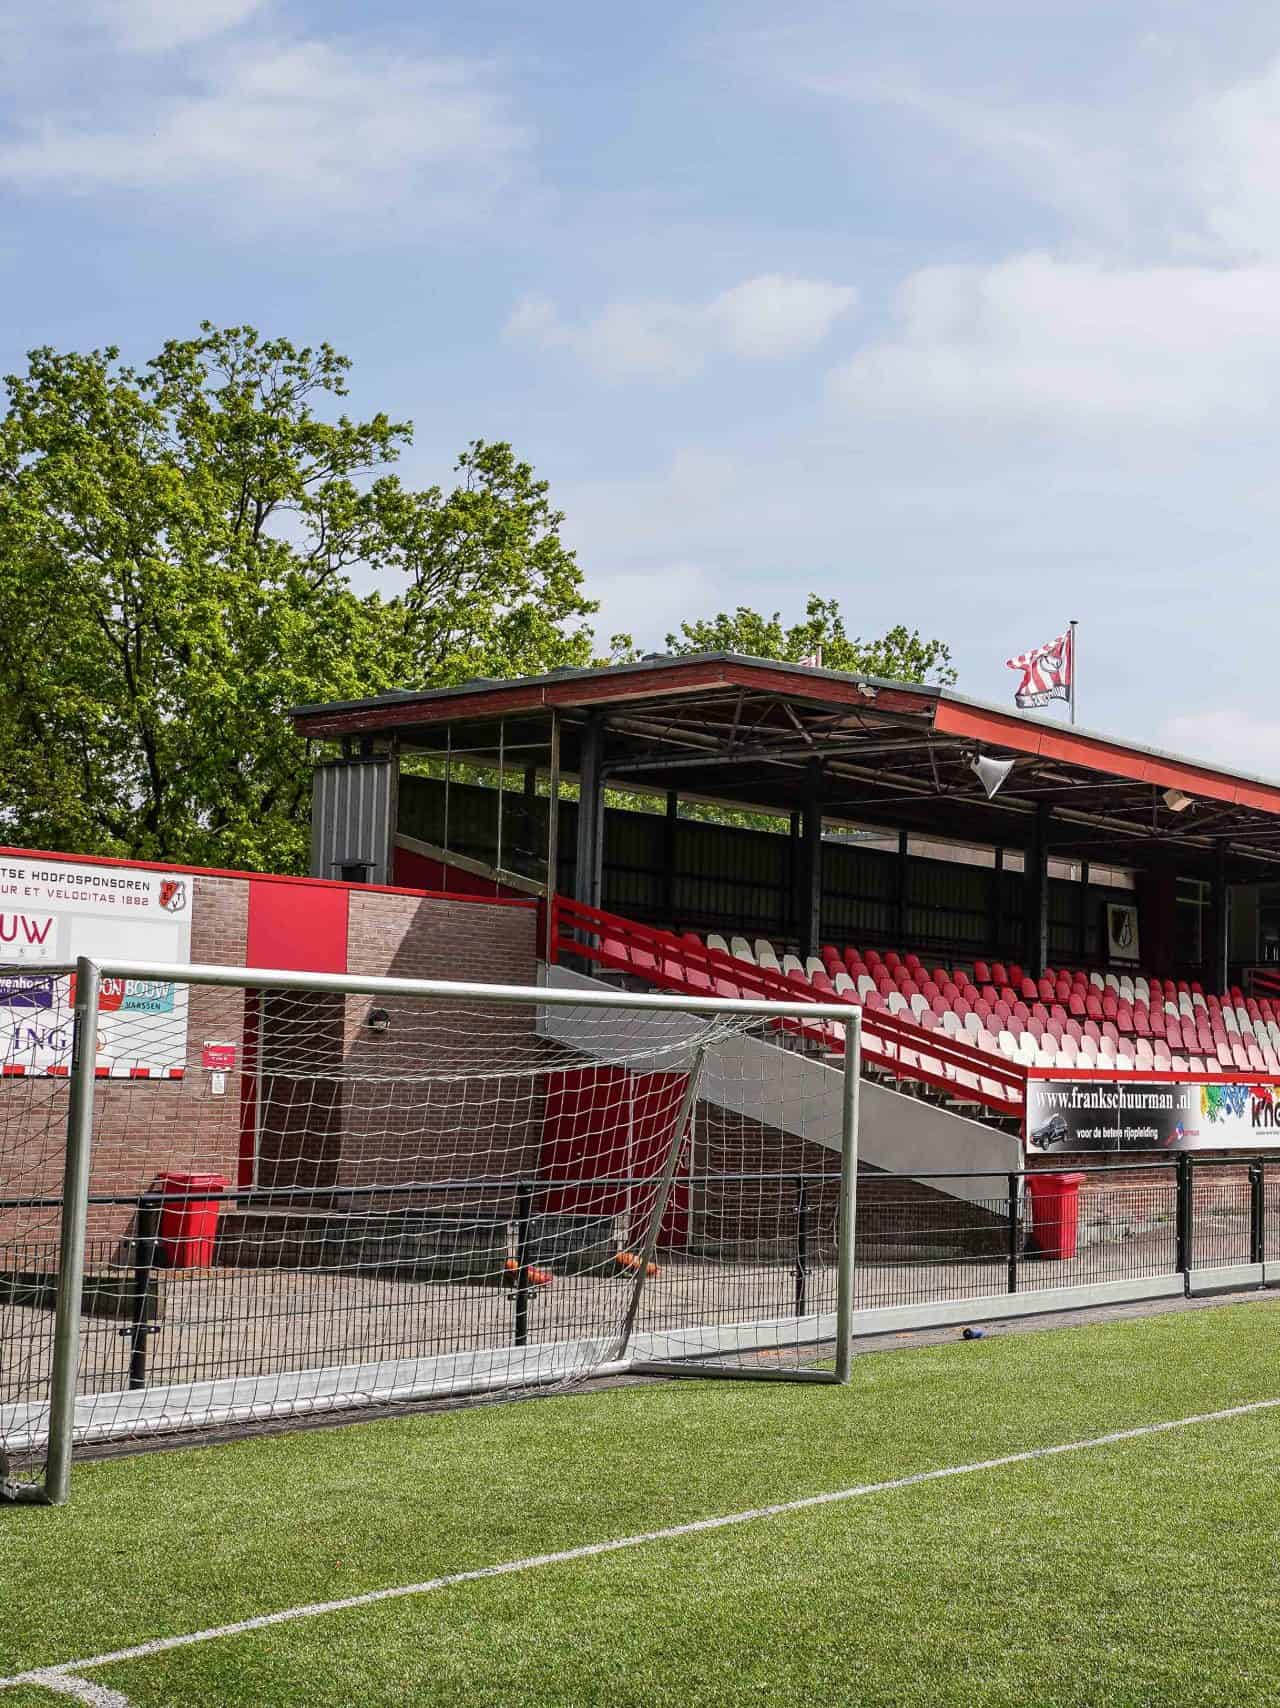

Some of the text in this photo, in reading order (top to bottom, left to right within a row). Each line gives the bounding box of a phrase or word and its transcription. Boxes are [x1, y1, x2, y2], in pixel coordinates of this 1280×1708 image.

[32, 871, 150, 891] HOOFDSPONSOREN
[24, 887, 40, 896] ET
[47, 888, 116, 904] VELOCITAS
[122, 895, 149, 906] 1882
[14, 1026, 68, 1051] ING
[1076, 1128, 1092, 1139] voor
[1093, 1127, 1102, 1138] de
[1123, 1127, 1159, 1140] rijopleiding
